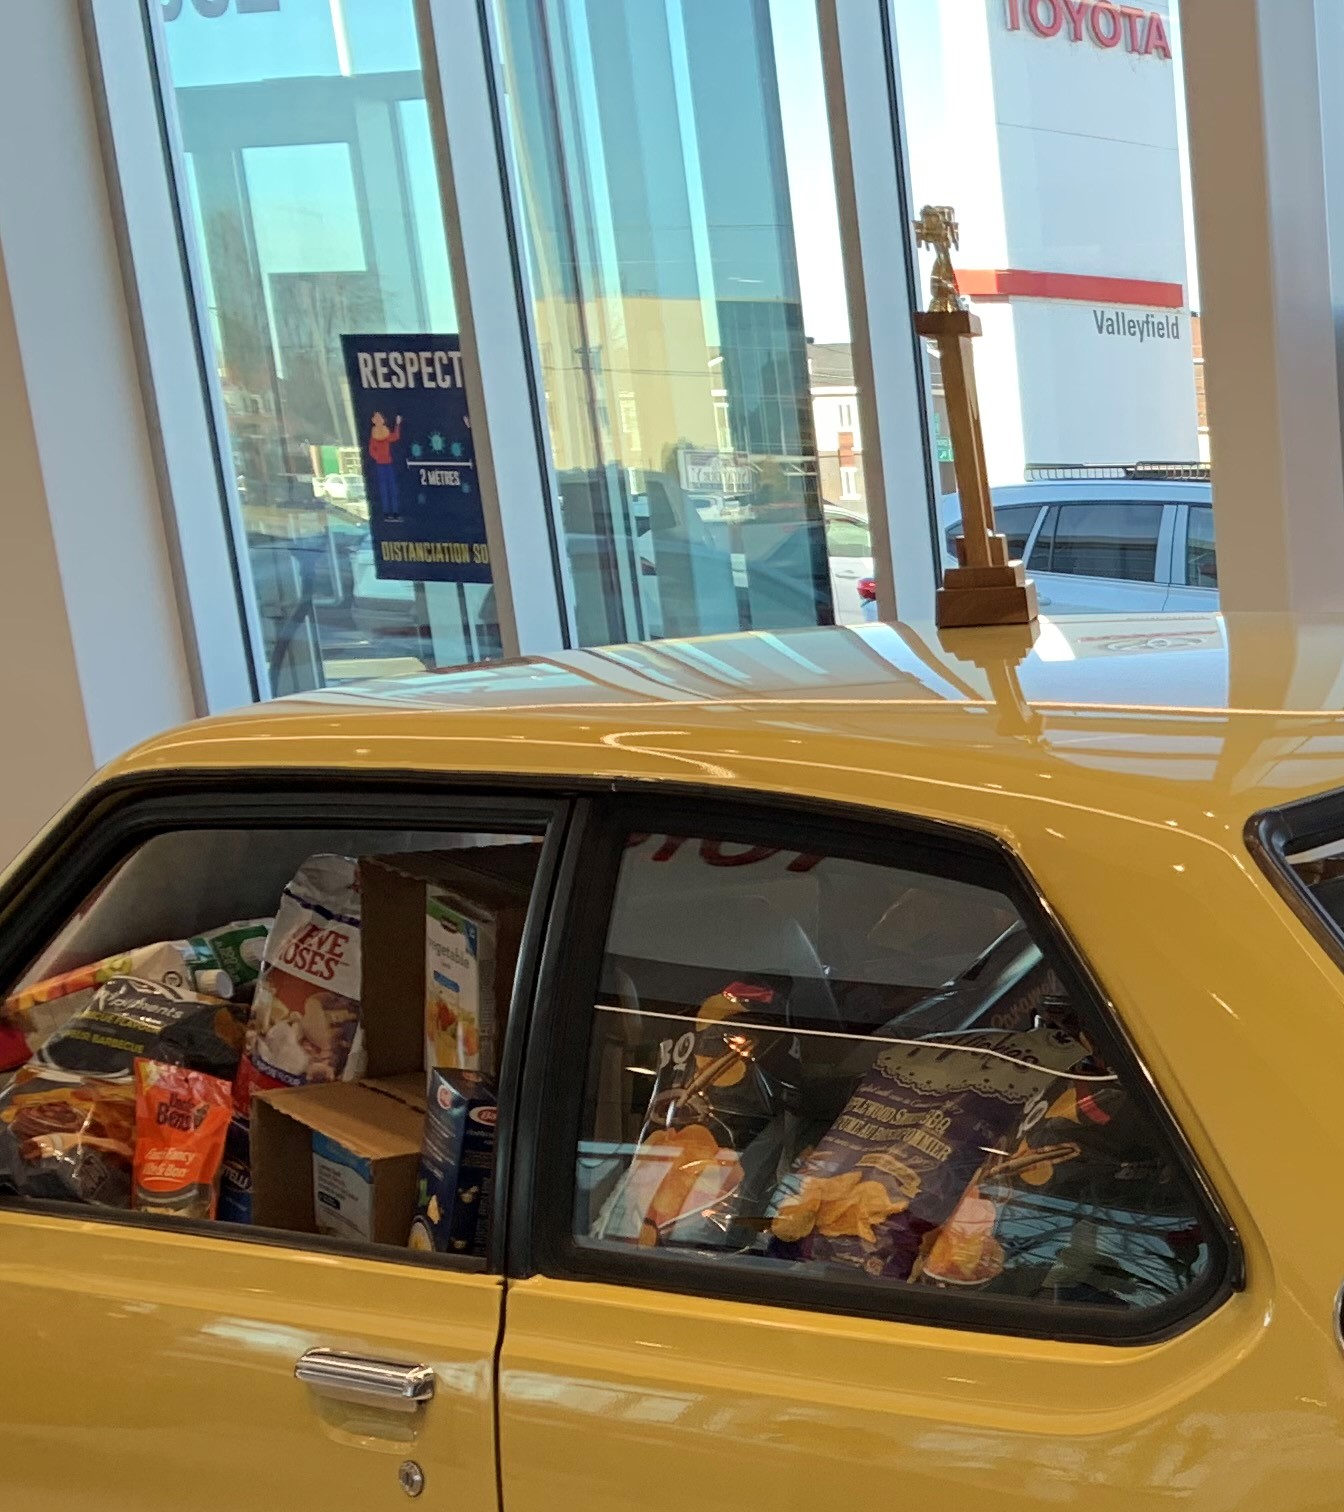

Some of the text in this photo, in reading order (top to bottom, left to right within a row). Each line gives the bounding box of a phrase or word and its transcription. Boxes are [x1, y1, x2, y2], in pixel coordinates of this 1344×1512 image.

[1002, 0, 1173, 60] TOYOTA
[1092, 309, 1180, 343] Valleyfield
[419, 468, 428, 487] 2
[380, 540, 470, 564] DISTANCIATION
